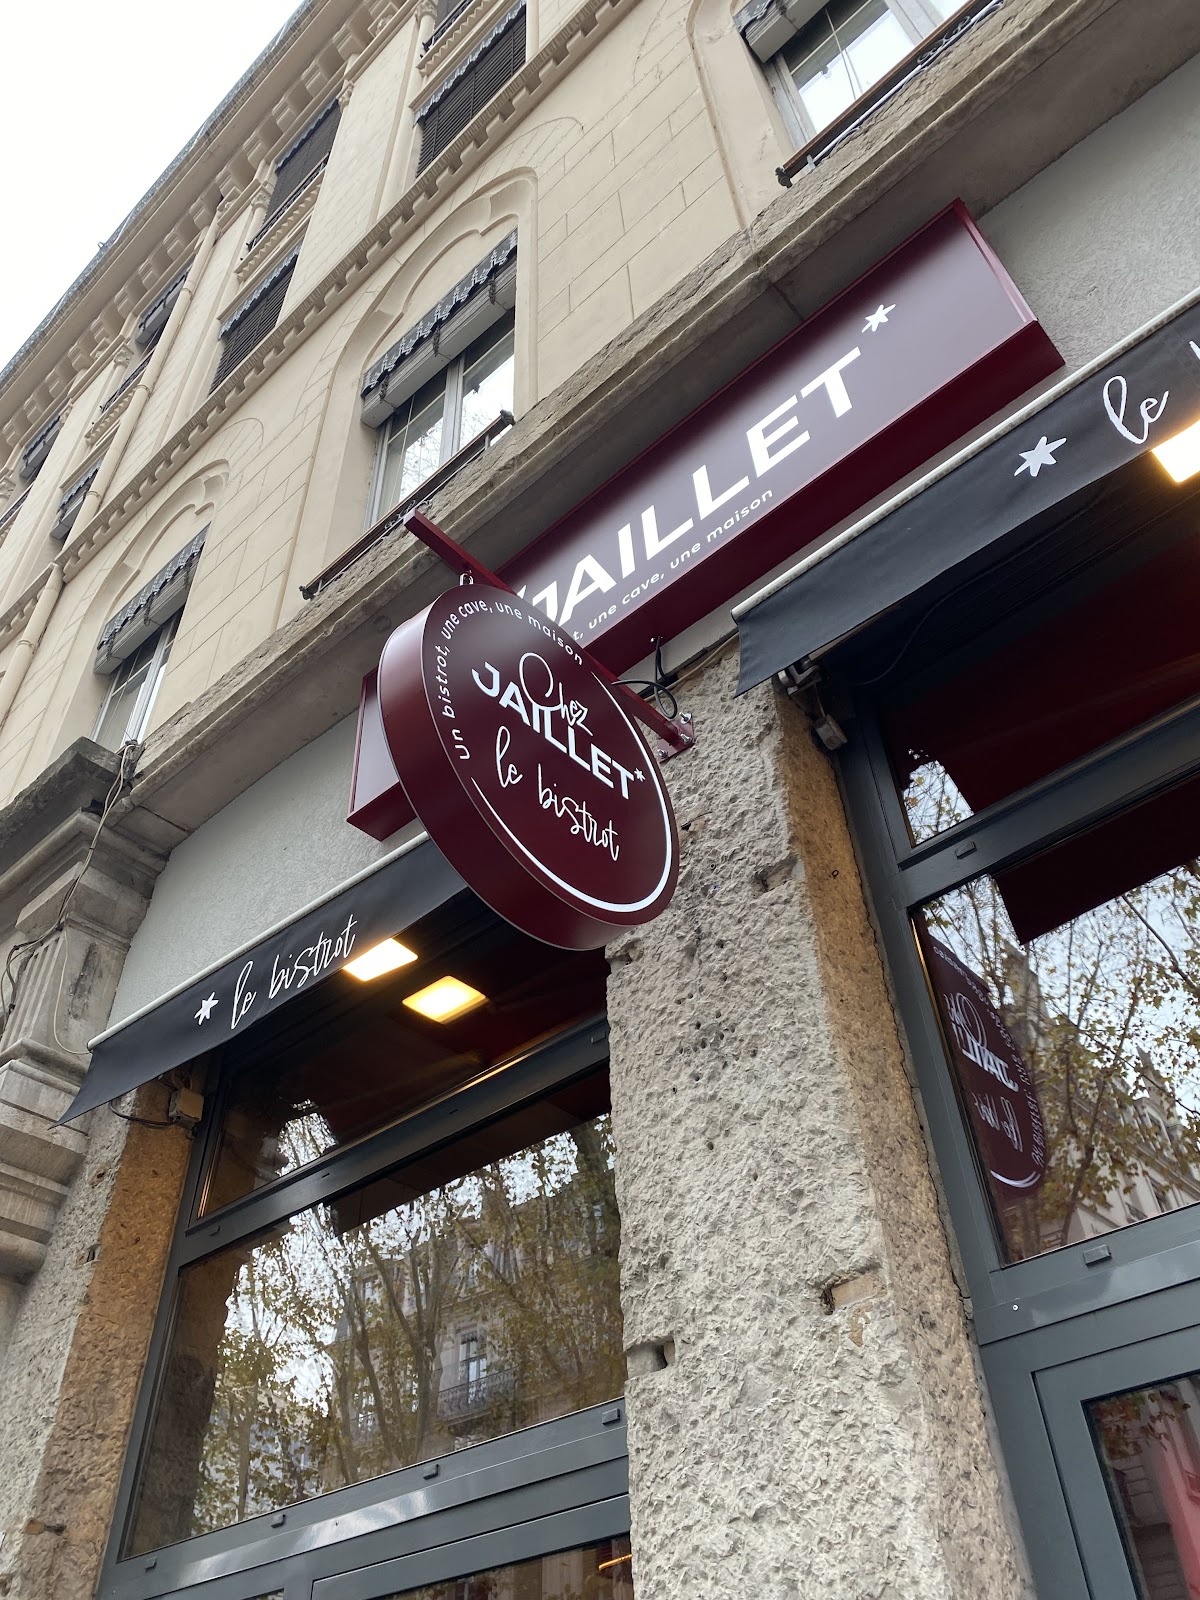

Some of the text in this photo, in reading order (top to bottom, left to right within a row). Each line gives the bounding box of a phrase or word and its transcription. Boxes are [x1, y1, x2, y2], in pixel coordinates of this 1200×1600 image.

[1102, 375, 1170, 445] le
[588, 489, 774, 630] une cave, une maison
[440, 612, 461, 640] une
[458, 598, 494, 617] cave,
[495, 601, 524, 621] une
[527, 614, 584, 666] maison
[437, 645, 456, 719] bistrot,
[518, 652, 594, 737] Chez
[450, 728, 471, 761] un
[495, 725, 621, 862] le bistrot
[230, 913, 358, 1030] le bistrot
